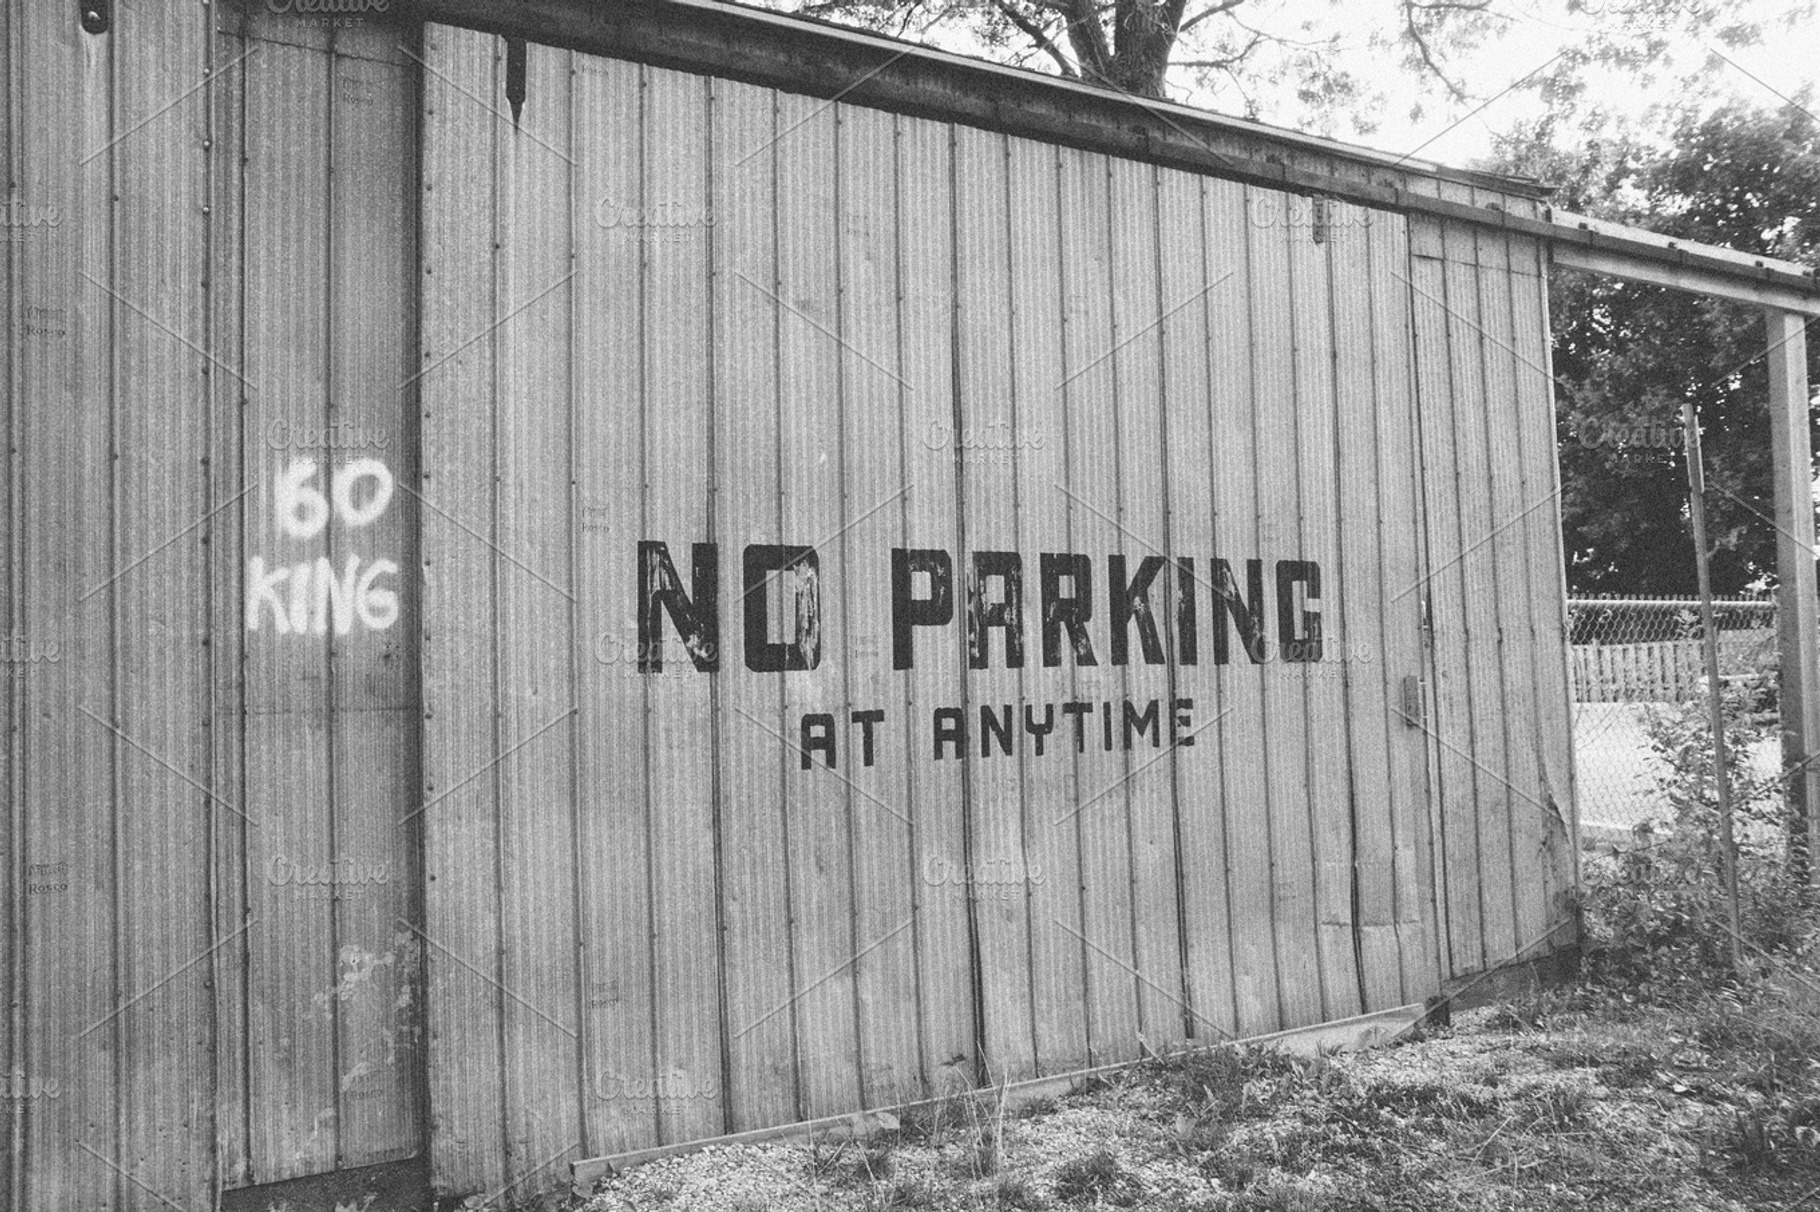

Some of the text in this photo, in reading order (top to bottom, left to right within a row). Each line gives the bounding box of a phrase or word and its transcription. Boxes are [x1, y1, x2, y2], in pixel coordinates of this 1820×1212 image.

[246, 552, 399, 635] KING
[637, 540, 1324, 673] NO PARKING
[801, 698, 1195, 771] AT ANYTIME
